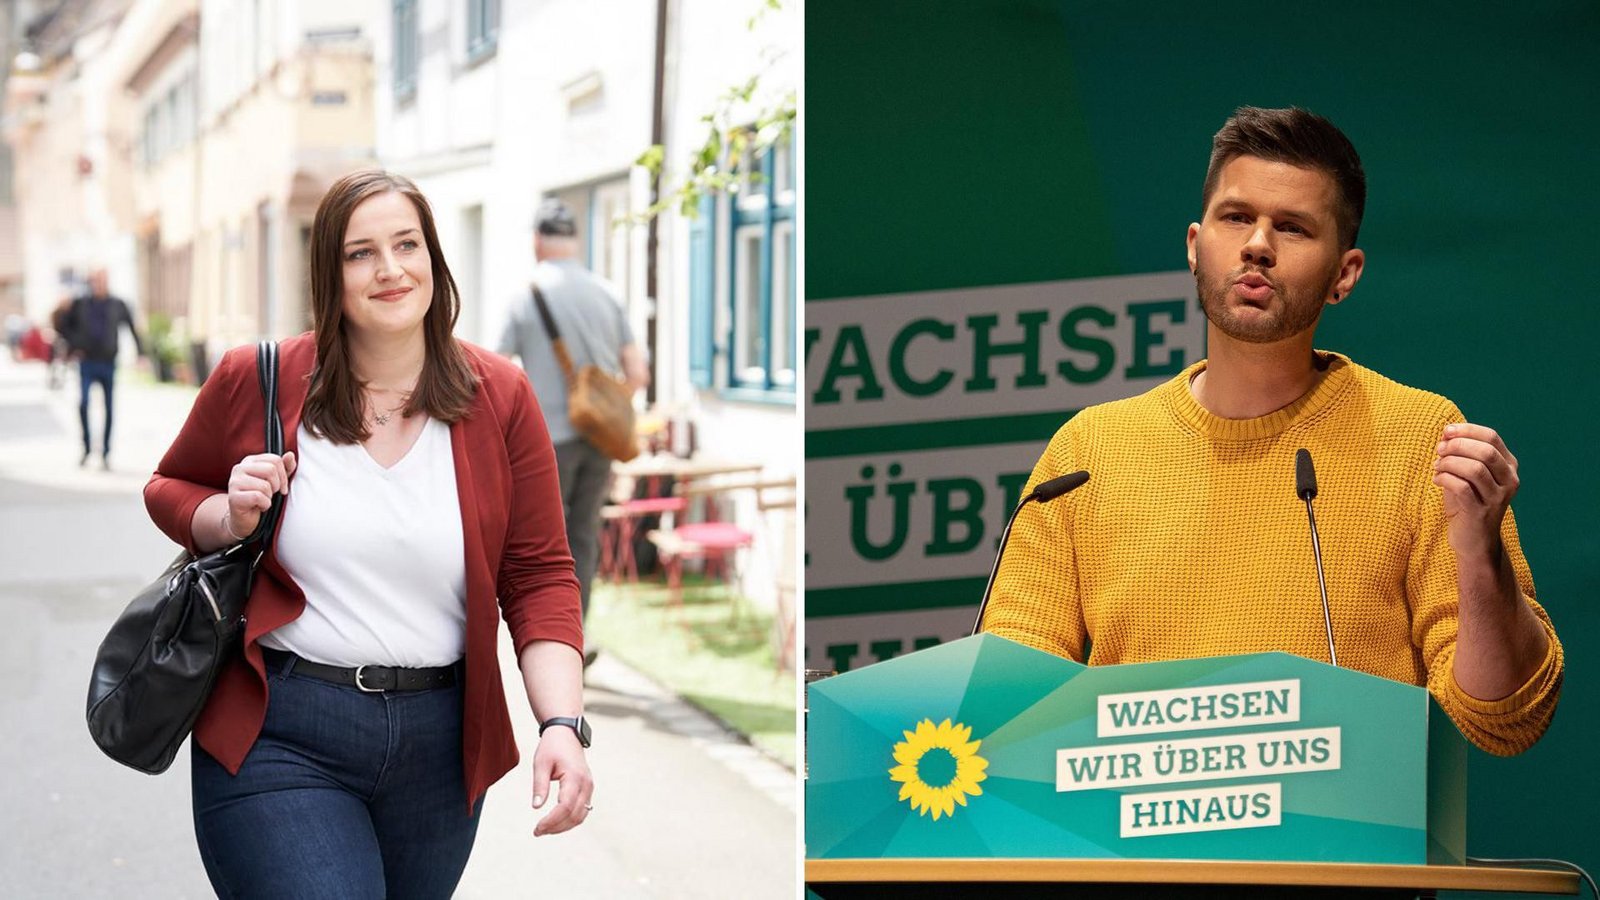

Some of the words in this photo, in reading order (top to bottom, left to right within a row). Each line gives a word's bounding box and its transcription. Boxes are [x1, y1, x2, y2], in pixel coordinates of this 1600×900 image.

[805, 298, 1208, 405] ACHSE
[1107, 688, 1291, 728] WACHSEN
[1067, 752, 1143, 783] WIR
[1153, 743, 1247, 776] ÜBER
[1257, 736, 1331, 768] UNS
[1131, 792, 1272, 829] HINAUS
